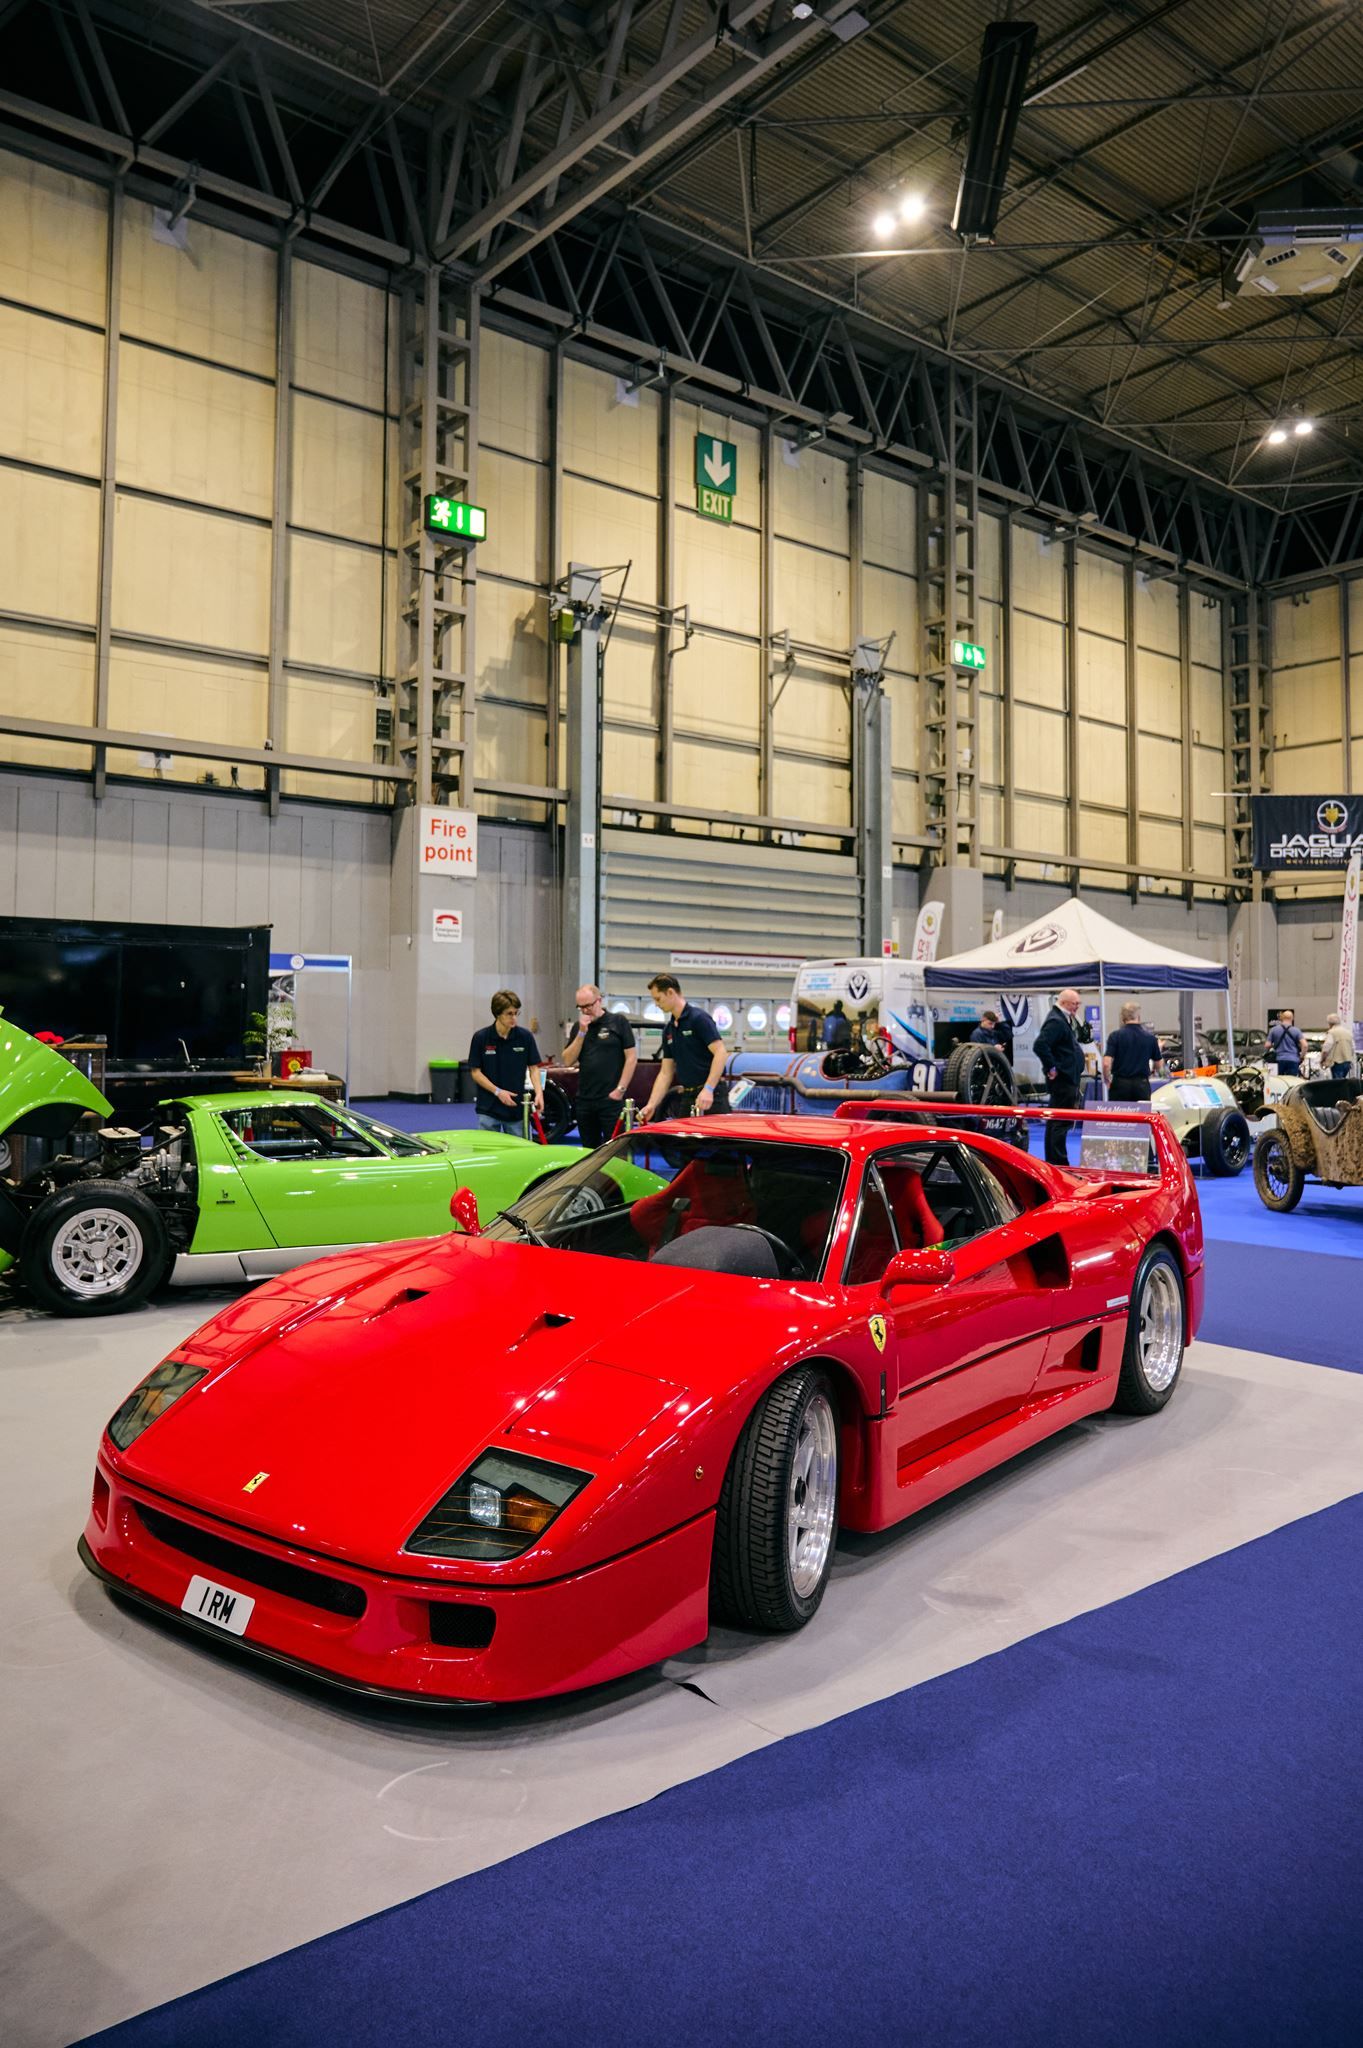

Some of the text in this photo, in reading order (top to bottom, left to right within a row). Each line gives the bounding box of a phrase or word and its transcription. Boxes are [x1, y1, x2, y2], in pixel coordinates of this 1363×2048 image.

[702, 489, 730, 518] EXIT
[430, 818, 467, 839] Fire
[425, 844, 473, 862] point
[1270, 847, 1347, 858] DRIVERS'
[912, 1063, 937, 1092] 91
[207, 1590, 237, 1624] RM
